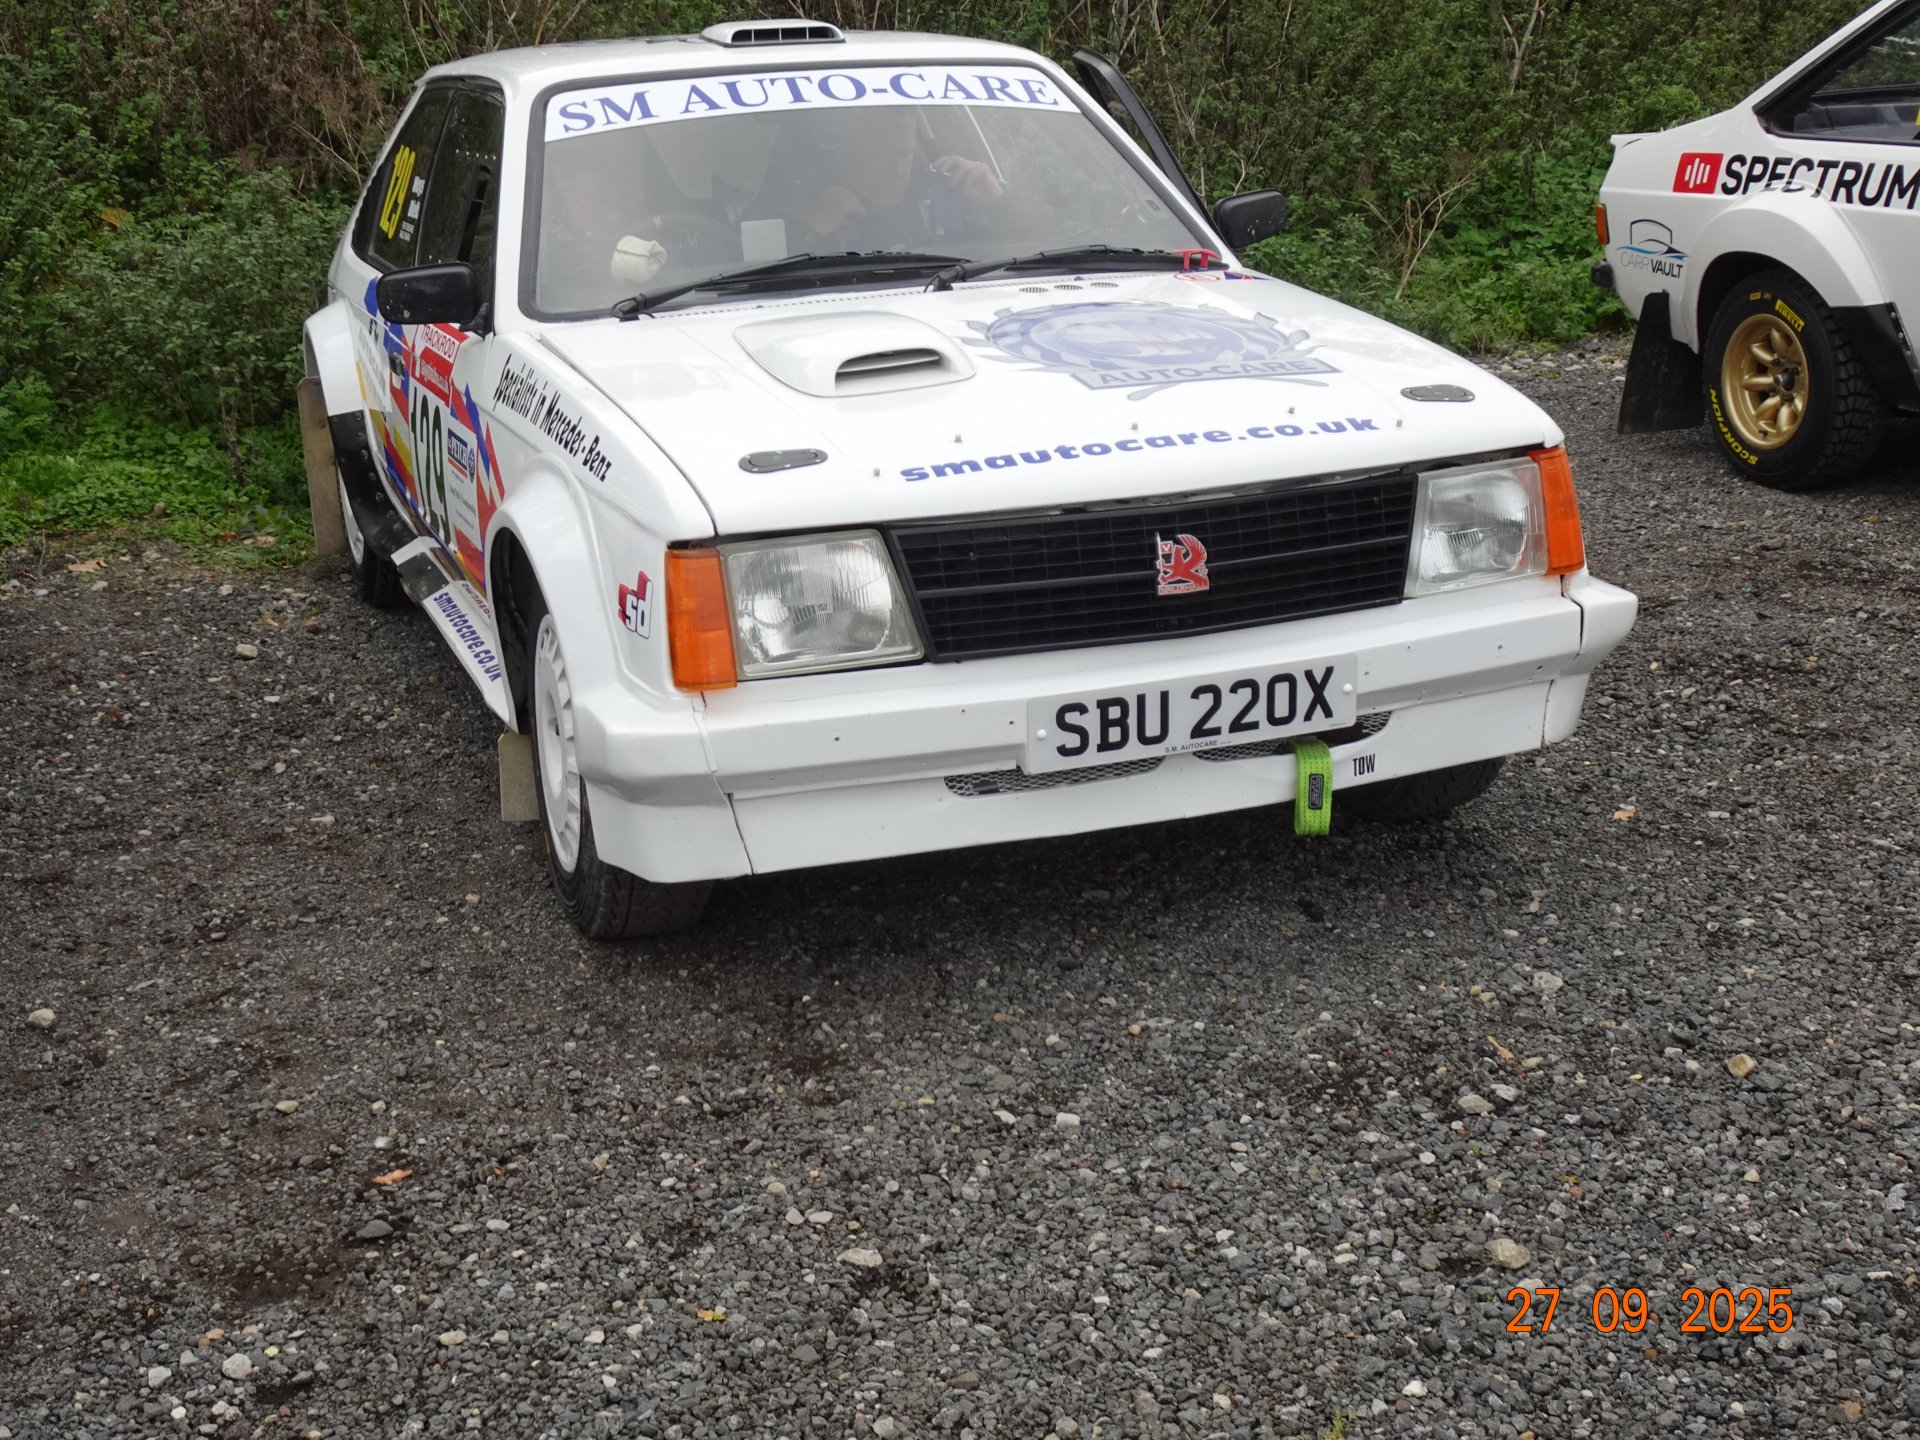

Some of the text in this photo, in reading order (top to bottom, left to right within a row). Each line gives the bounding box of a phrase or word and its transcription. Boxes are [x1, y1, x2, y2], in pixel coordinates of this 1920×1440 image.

[556, 72, 1060, 133] SM AUTO-CARE
[380, 144, 416, 239] 129
[1721, 153, 1920, 211] SPECTRUM
[419, 325, 456, 359] TRACKROD
[1100, 357, 1317, 386] AUTO-CARE
[493, 353, 538, 412] Specialists
[530, 381, 547, 426] in
[900, 416, 1380, 483] smautocare.co.uk
[1710, 387, 1759, 465] SCORPION
[411, 386, 451, 545] 129
[1055, 666, 1335, 758] SBU 220X
[1181, 740, 1219, 751] AUTOCARE
[1352, 753, 1376, 777] TOW
